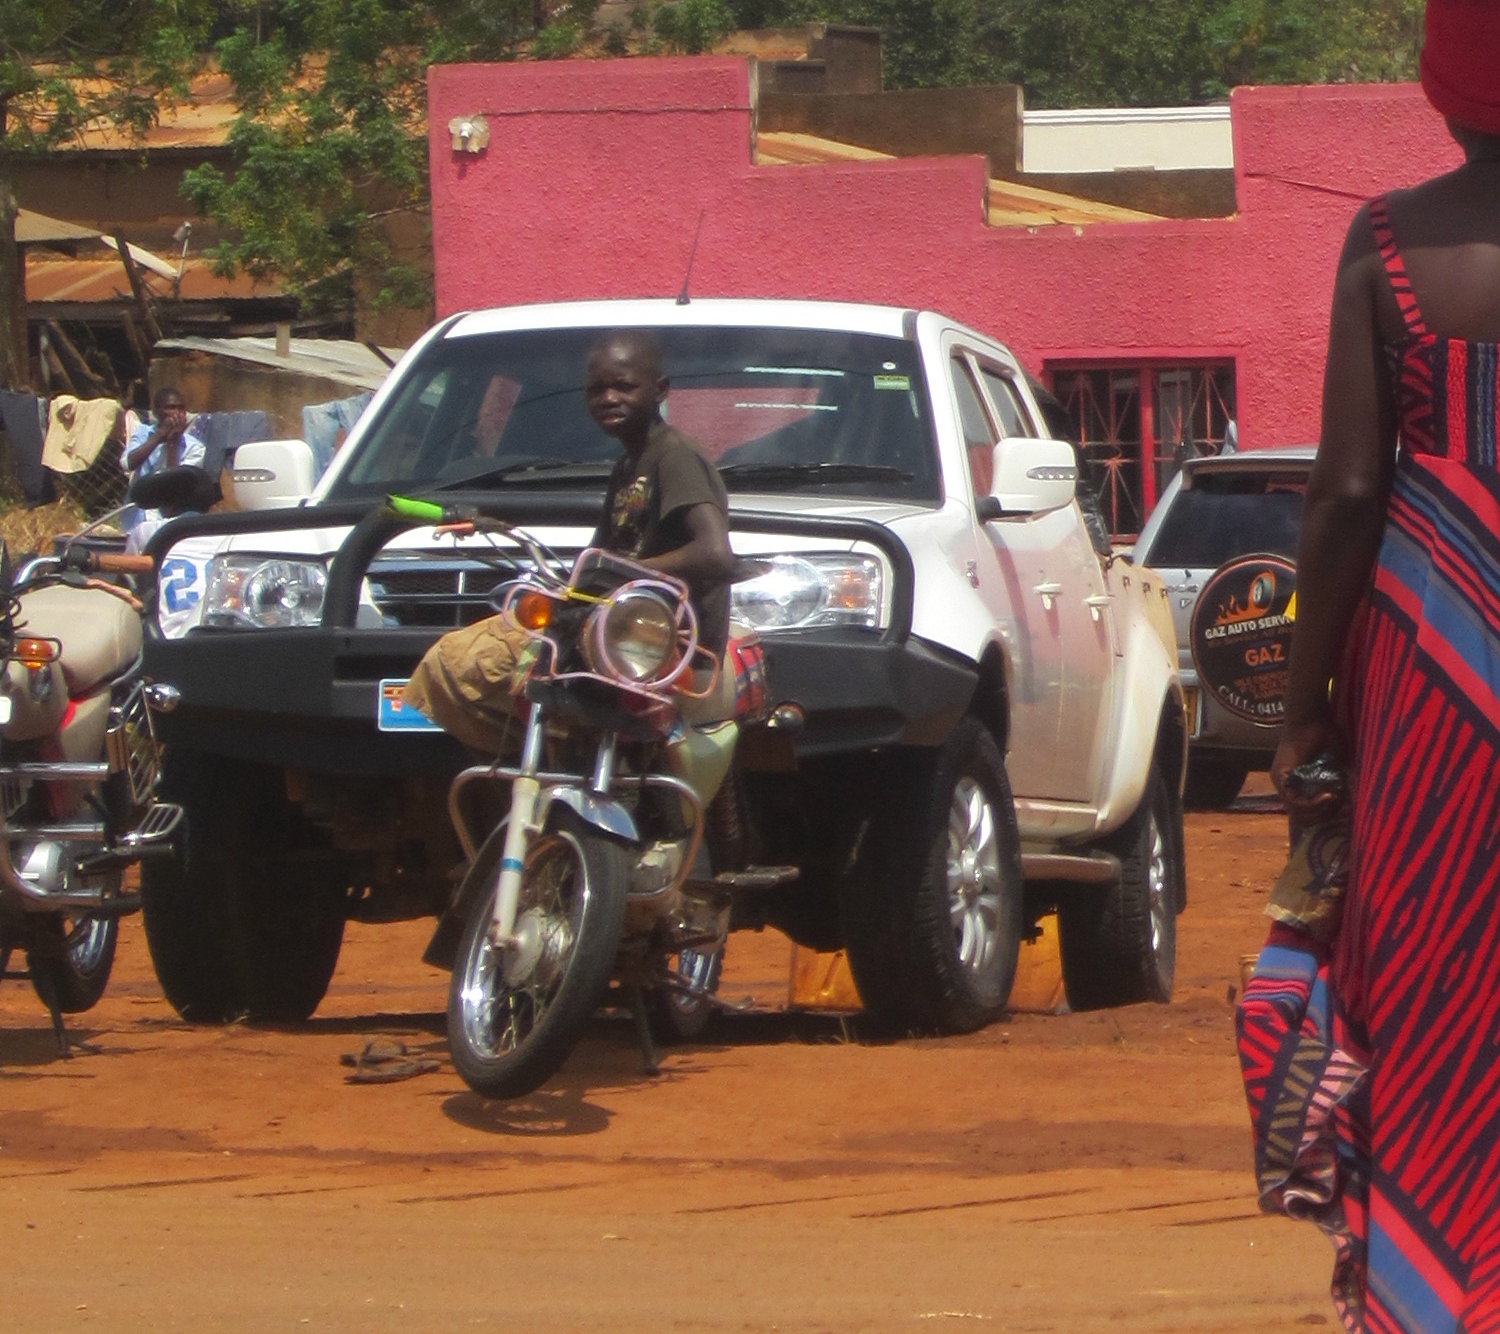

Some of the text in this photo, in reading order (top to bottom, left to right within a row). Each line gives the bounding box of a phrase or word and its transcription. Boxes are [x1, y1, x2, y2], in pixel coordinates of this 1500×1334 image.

[1205, 625, 1227, 640] GAZ
[1228, 620, 1256, 636] AUTO
[1245, 643, 1285, 667] GAZ
